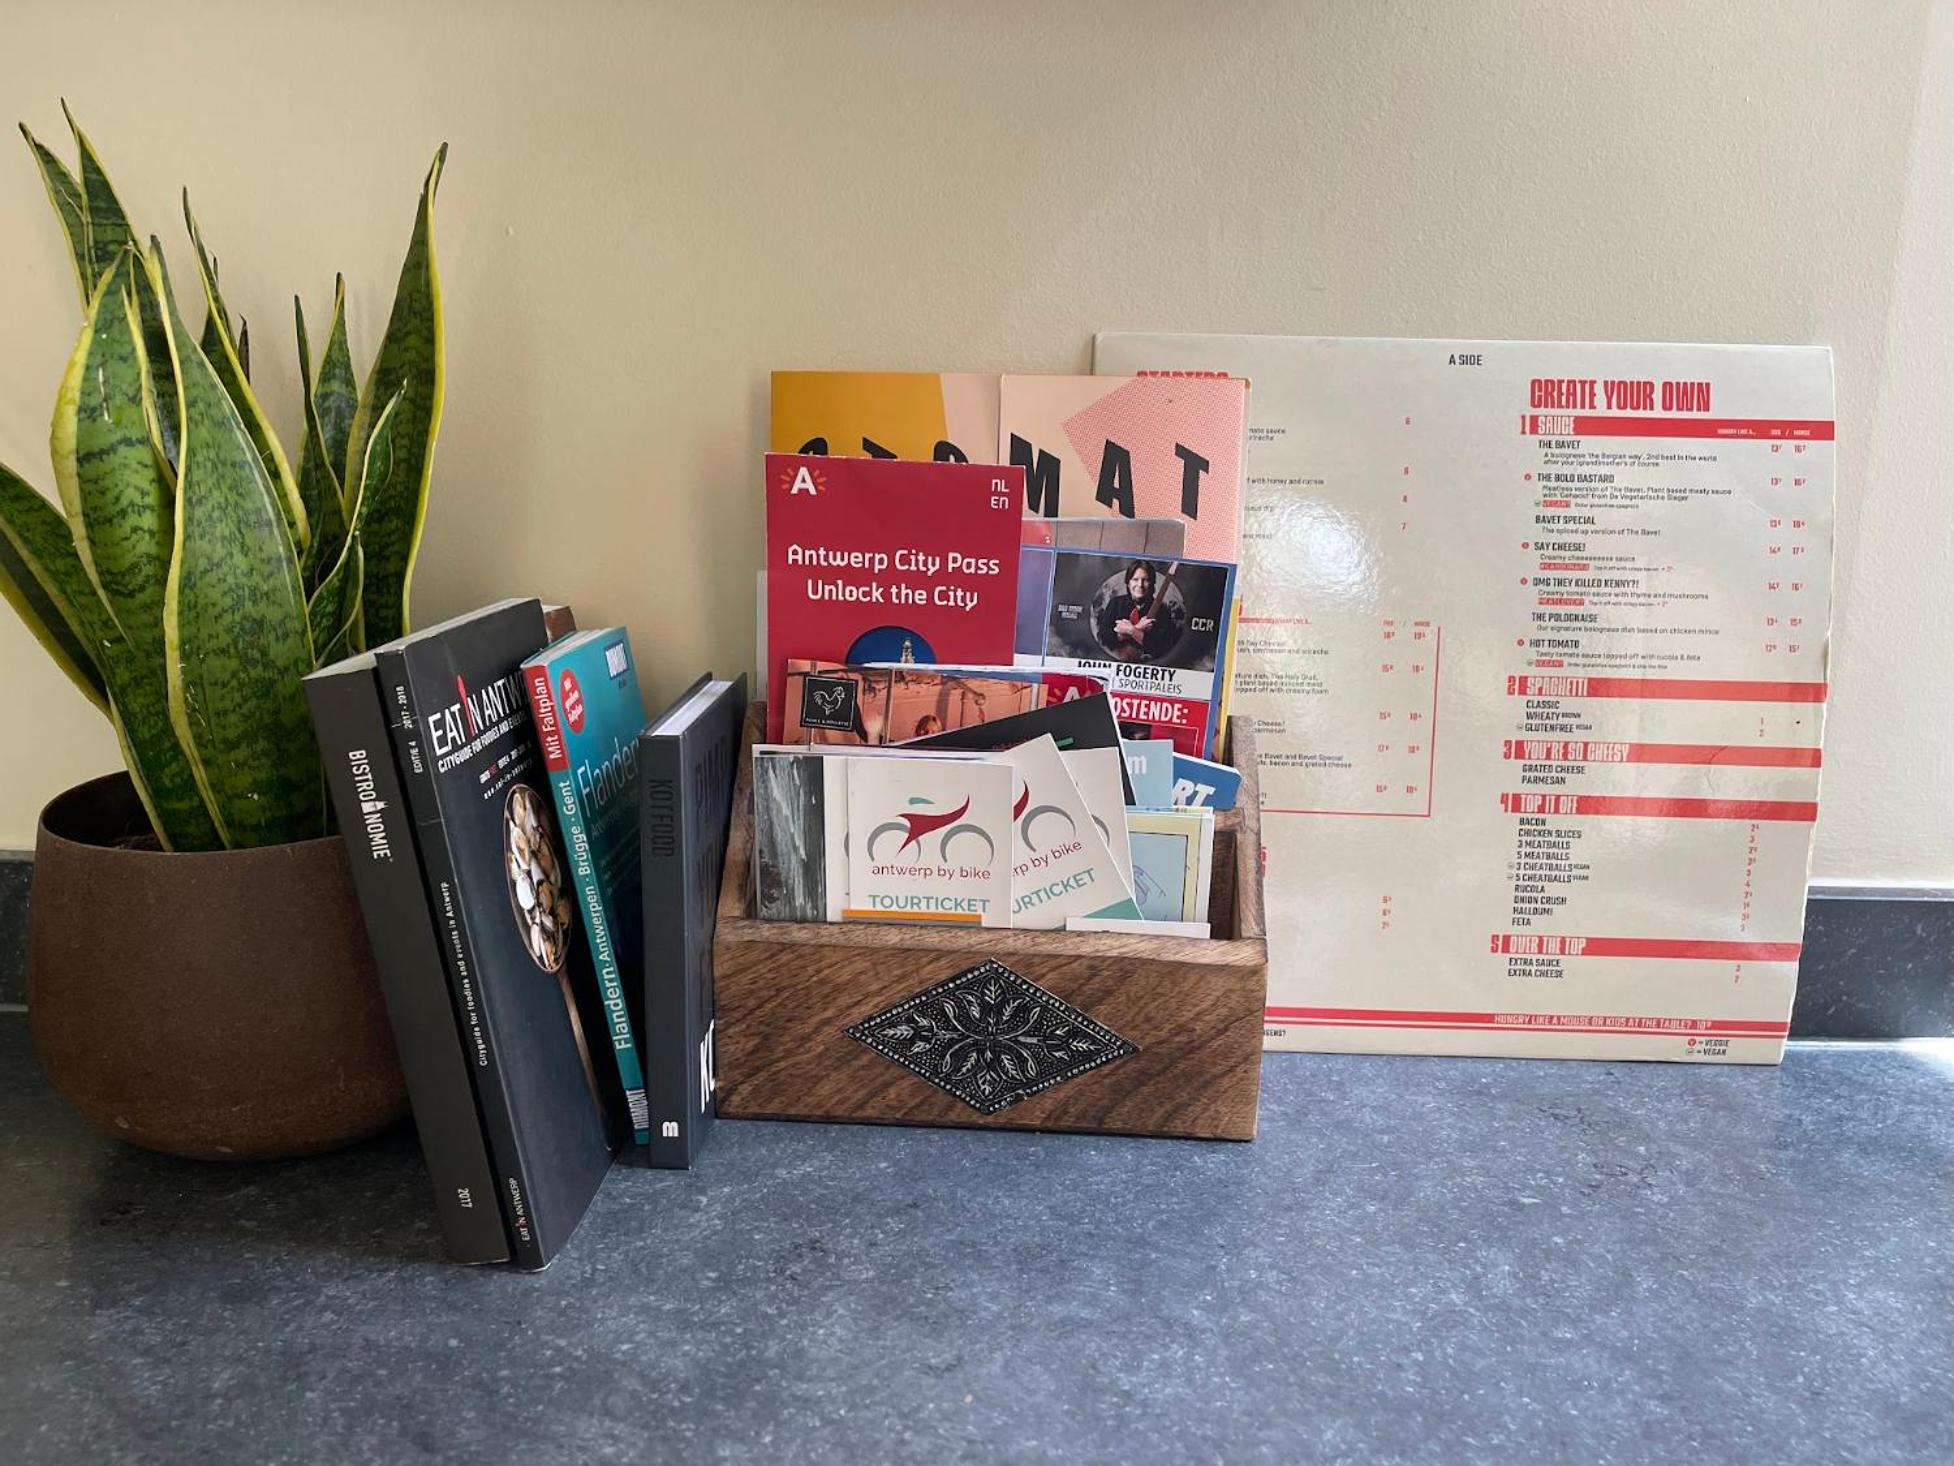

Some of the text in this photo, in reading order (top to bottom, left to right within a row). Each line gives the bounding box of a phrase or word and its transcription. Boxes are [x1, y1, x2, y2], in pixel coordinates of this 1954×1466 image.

[1449, 354, 1482, 367] A SIDE
[1530, 378, 1711, 412] CREATE YOUR OWN
[1520, 414, 1575, 436] 1 SAUCE
[1538, 439, 1582, 450] THE BAVET
[1537, 473, 1615, 484] THE BOLD BASTARD
[1535, 515, 1596, 526] BAVET SPECIAL
[1534, 542, 1586, 552] SAY CHEESE!
[787, 543, 1000, 576] Antwerp City Pass
[1533, 577, 1639, 588] OMG THEY KILLED KENNY?!
[807, 578, 978, 610] Unlock the City
[1532, 612, 1547, 622] THE
[1191, 617, 1215, 632] CCR
[1529, 639, 1580, 650] HOT TOMATO
[1116, 664, 1177, 682] FOGERTY
[1118, 678, 1183, 695] SPORTPALEIS
[1526, 676, 1589, 697] SPAGHETTI
[1526, 700, 1560, 710] CLASSIC
[534, 677, 563, 760] Mit Faltplan
[1526, 711, 1560, 721] WHEATY
[428, 704, 466, 756] EAT
[1525, 723, 1575, 733] GLUTENFREE
[1524, 741, 1566, 761] YOU'RE
[1568, 742, 1585, 761] SO
[1587, 742, 1630, 762] CHEESY
[438, 745, 473, 773] CITYGUIDE
[1522, 764, 1586, 775] GRATED CHEESE
[1521, 776, 1566, 785] PARMESAN
[558, 780, 576, 815] Gent
[1520, 794, 1542, 813] TOP
[1545, 794, 1555, 814] IT
[1559, 795, 1578, 814] OFF
[649, 778, 675, 858] KOTFOOD
[1519, 817, 1546, 827] BACON
[1518, 828, 1582, 839] CHICKEN SLICES
[1517, 840, 1571, 850] 3 MEATBALLS
[1031, 853, 1050, 871] by
[1051, 840, 1083, 860] bike
[1516, 851, 1570, 861] 5 MEATBALLS
[872, 864, 991, 881] antwerp by bike
[1516, 862, 1522, 871] 3
[1523, 862, 1573, 872] CHEATBALLS
[1515, 873, 1521, 882] 5
[1522, 873, 1572, 883] CHEATBALLS
[1012, 867, 1096, 915] URTICKET
[1514, 884, 1545, 894] RUCOLA
[441, 881, 455, 918] Antwerp
[868, 894, 991, 914] TOURTICKET
[1513, 895, 1567, 905] ONION CRUSH
[1513, 906, 1553, 916] HALLOUMI
[448, 919, 456, 929] in
[1512, 917, 1531, 926] FETA
[1509, 935, 1538, 954] OVER
[1543, 936, 1561, 955] THE
[1565, 937, 1587, 955] TOP
[457, 960, 468, 976] and
[1509, 957, 1561, 968] EXTRA SAUCE
[1508, 968, 1564, 979] EXTRA CHEESE
[463, 978, 475, 1010] foodies
[470, 1012, 479, 1025] for
[1494, 1014, 1530, 1024] HUNGRY
[1531, 1015, 1550, 1025] LIKE
[1551, 1016, 1558, 1025] A
[1560, 1016, 1590, 1026] MOUSE
[1592, 1017, 1604, 1027] OR
[1606, 1017, 1626, 1027] KIDS
[1627, 1018, 1639, 1028] AT
[1640, 1018, 1658, 1028] THE
[474, 1026, 488, 1067] Cityguide
[626, 1088, 649, 1129] DUMONT
[457, 1187, 473, 1208] 2017
[509, 1177, 524, 1216] ANTWERP
